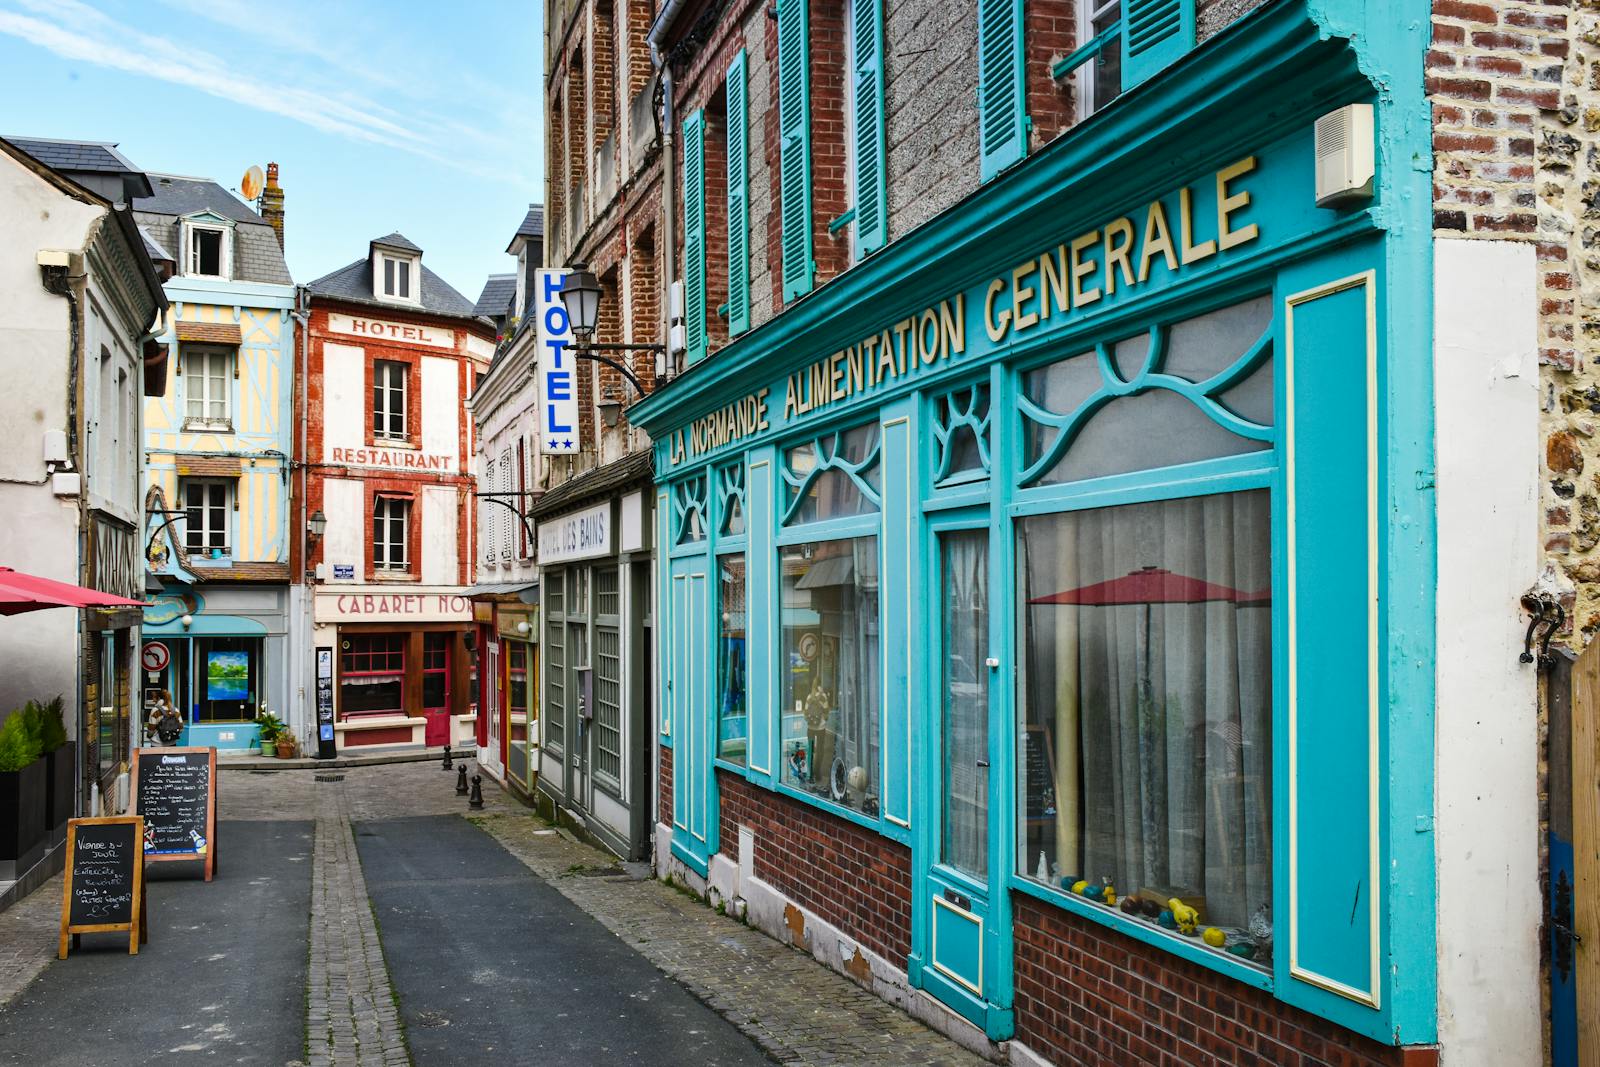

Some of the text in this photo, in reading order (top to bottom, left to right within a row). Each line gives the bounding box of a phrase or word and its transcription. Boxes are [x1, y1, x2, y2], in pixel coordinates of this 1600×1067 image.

[669, 156, 1259, 466] LA NORMANDE ALIMENTATION GENERALE
[352, 319, 432, 343] HOTEL
[544, 274, 572, 433] HOTEL
[332, 448, 453, 470] RESTAURANT
[580, 511, 604, 551] BAINS
[337, 594, 425, 614] CABARET
